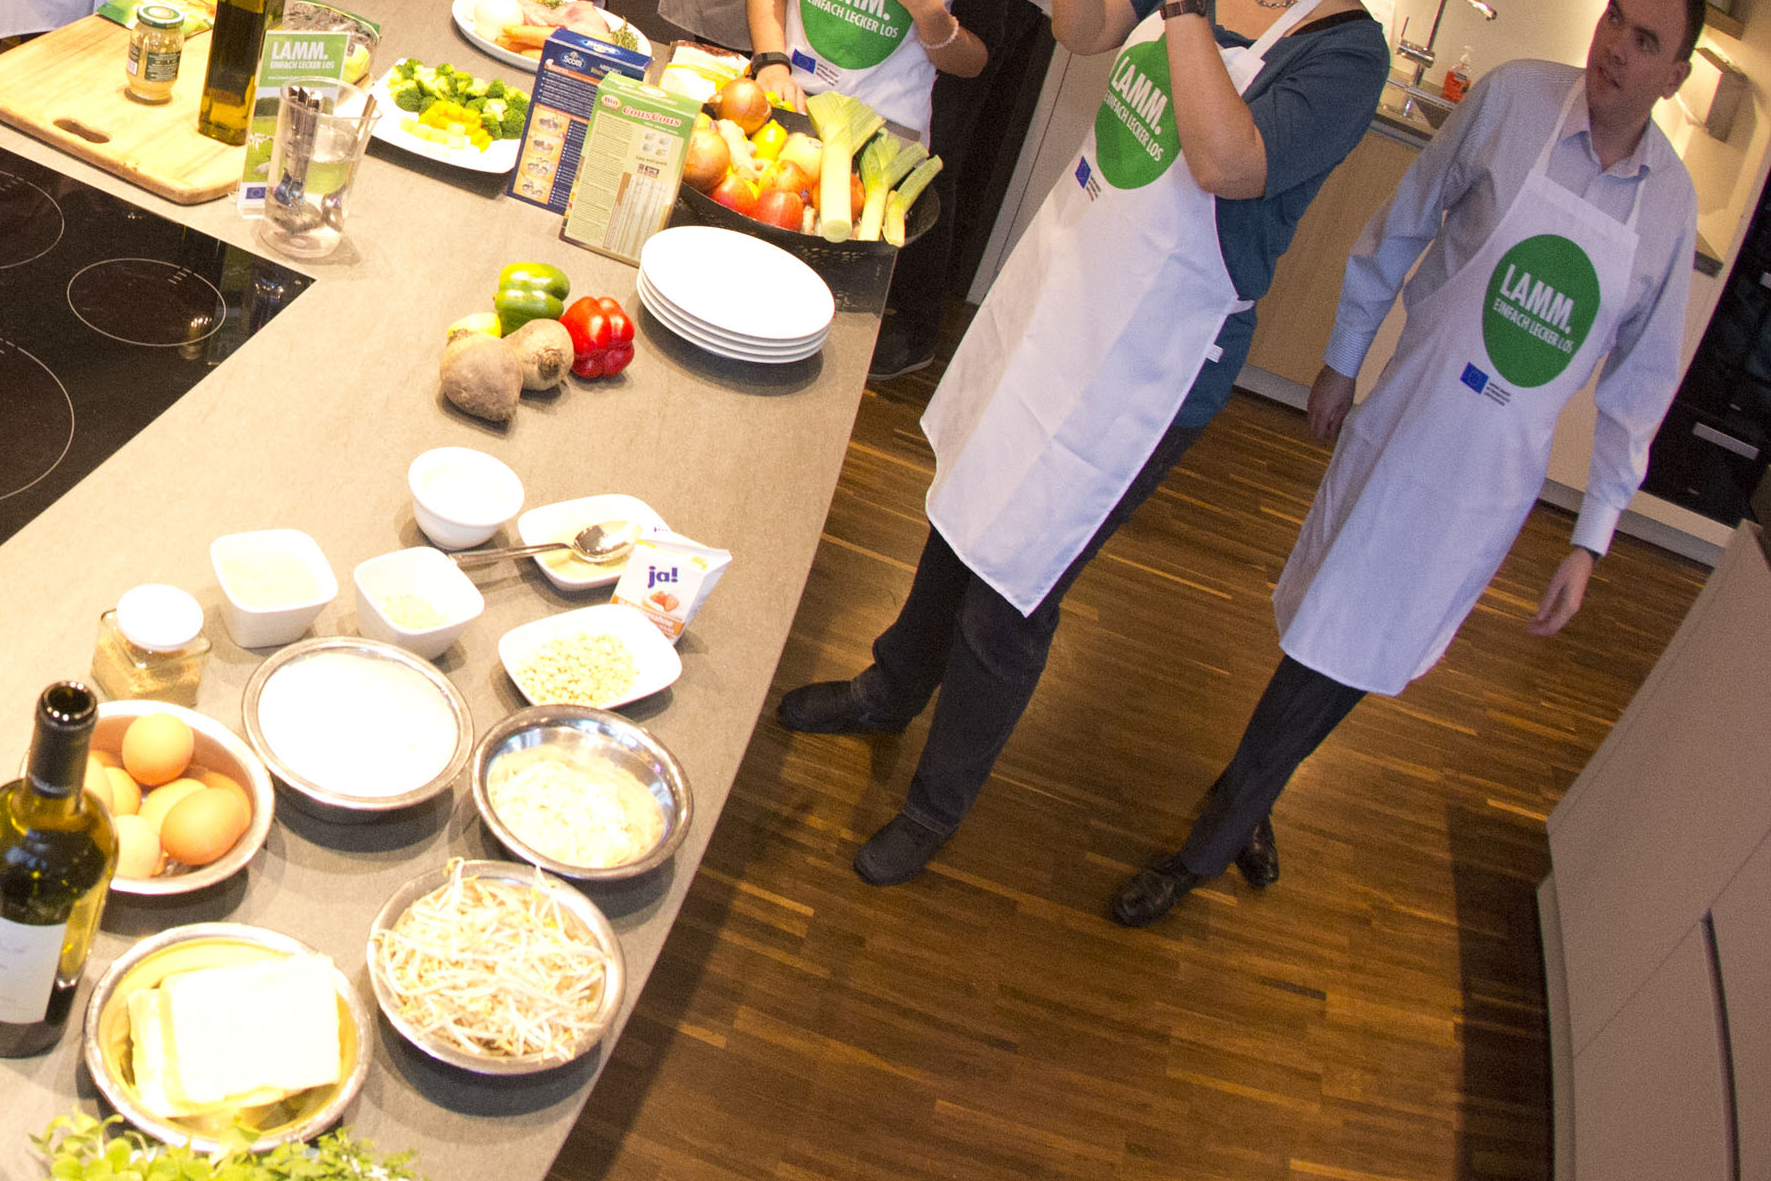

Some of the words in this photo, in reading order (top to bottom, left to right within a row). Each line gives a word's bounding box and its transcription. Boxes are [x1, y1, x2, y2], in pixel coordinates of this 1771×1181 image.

[844, 7, 879, 34] LECKER
[879, 23, 899, 39] LOS
[269, 60, 297, 69] EINFACH
[298, 61, 321, 69] LECKER
[322, 61, 335, 69] LOS
[271, 41, 328, 60] LAMM.
[1110, 55, 1168, 135] LAMM.
[622, 106, 682, 127] CousCous
[1104, 90, 1129, 123] EINFACH
[1126, 114, 1151, 147] LECKER
[1146, 141, 1164, 162] LOS
[1499, 263, 1575, 335] LAMM.
[1492, 297, 1530, 330] EINFACH
[1528, 318, 1560, 348] LECKER
[1557, 338, 1575, 354] LOS
[647, 565, 679, 589] ja!
